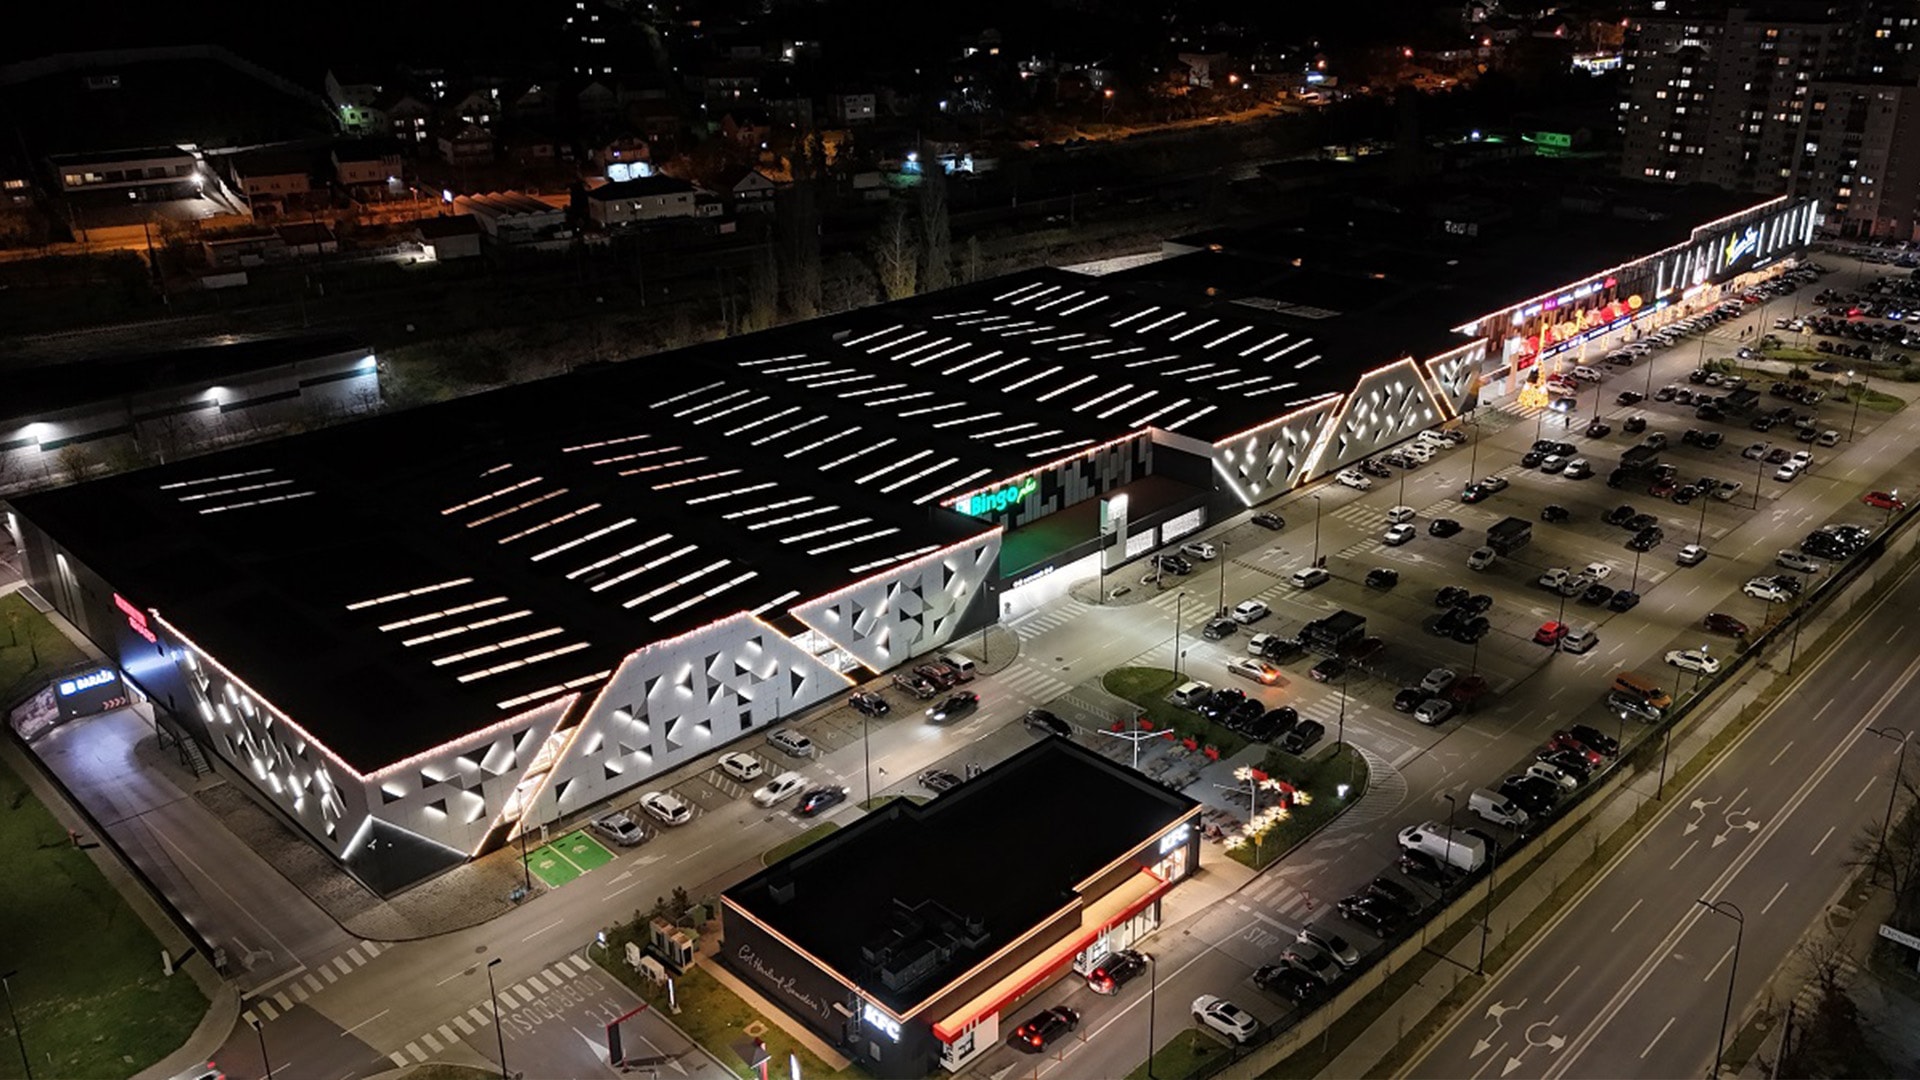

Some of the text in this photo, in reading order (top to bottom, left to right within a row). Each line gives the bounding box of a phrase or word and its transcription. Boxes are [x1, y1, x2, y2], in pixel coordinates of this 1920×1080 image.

[970, 486, 1018, 516] Bingo
[1159, 823, 1190, 854] KFC
[1243, 926, 1280, 949] STOP
[862, 1003, 901, 1044] KFC
